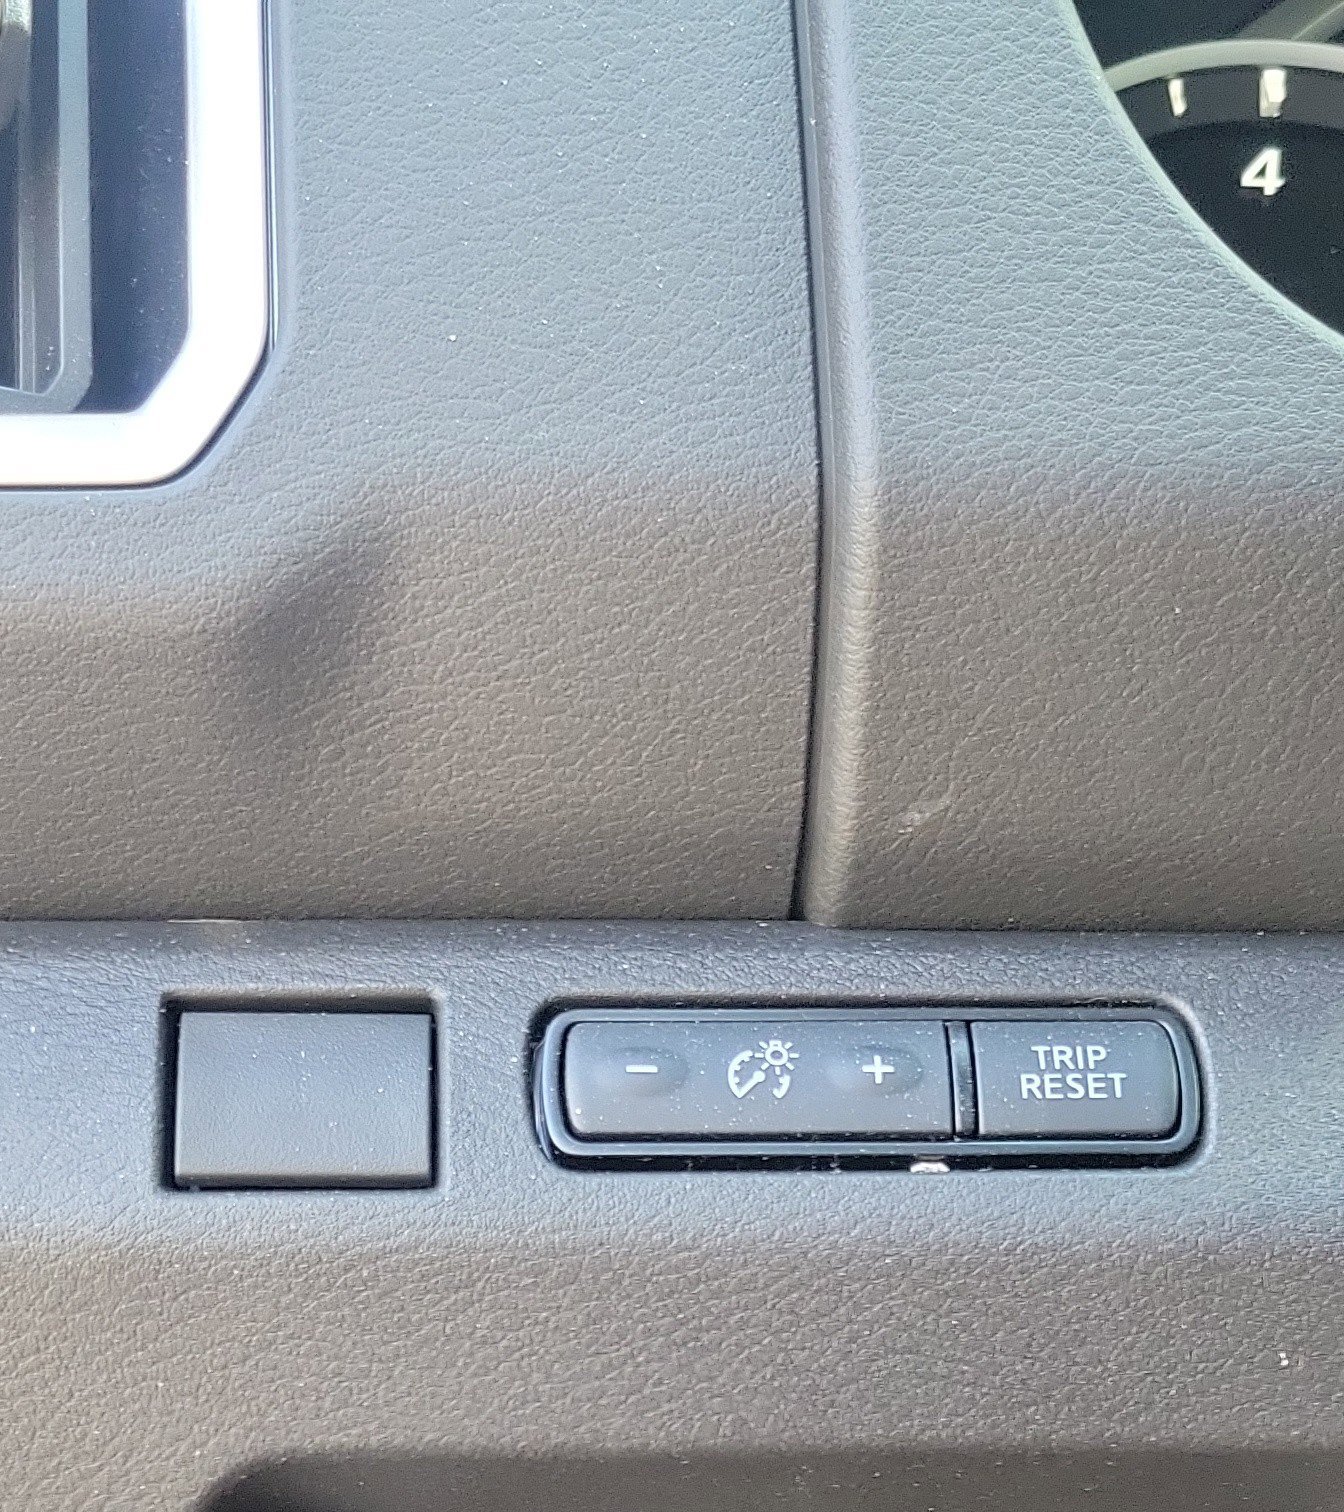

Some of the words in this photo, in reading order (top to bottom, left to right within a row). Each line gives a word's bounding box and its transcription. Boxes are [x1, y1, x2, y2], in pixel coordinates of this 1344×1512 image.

[1240, 146, 1286, 196] 4
[1029, 1045, 1108, 1070] TRIP
[1019, 1072, 1127, 1100] RESET
